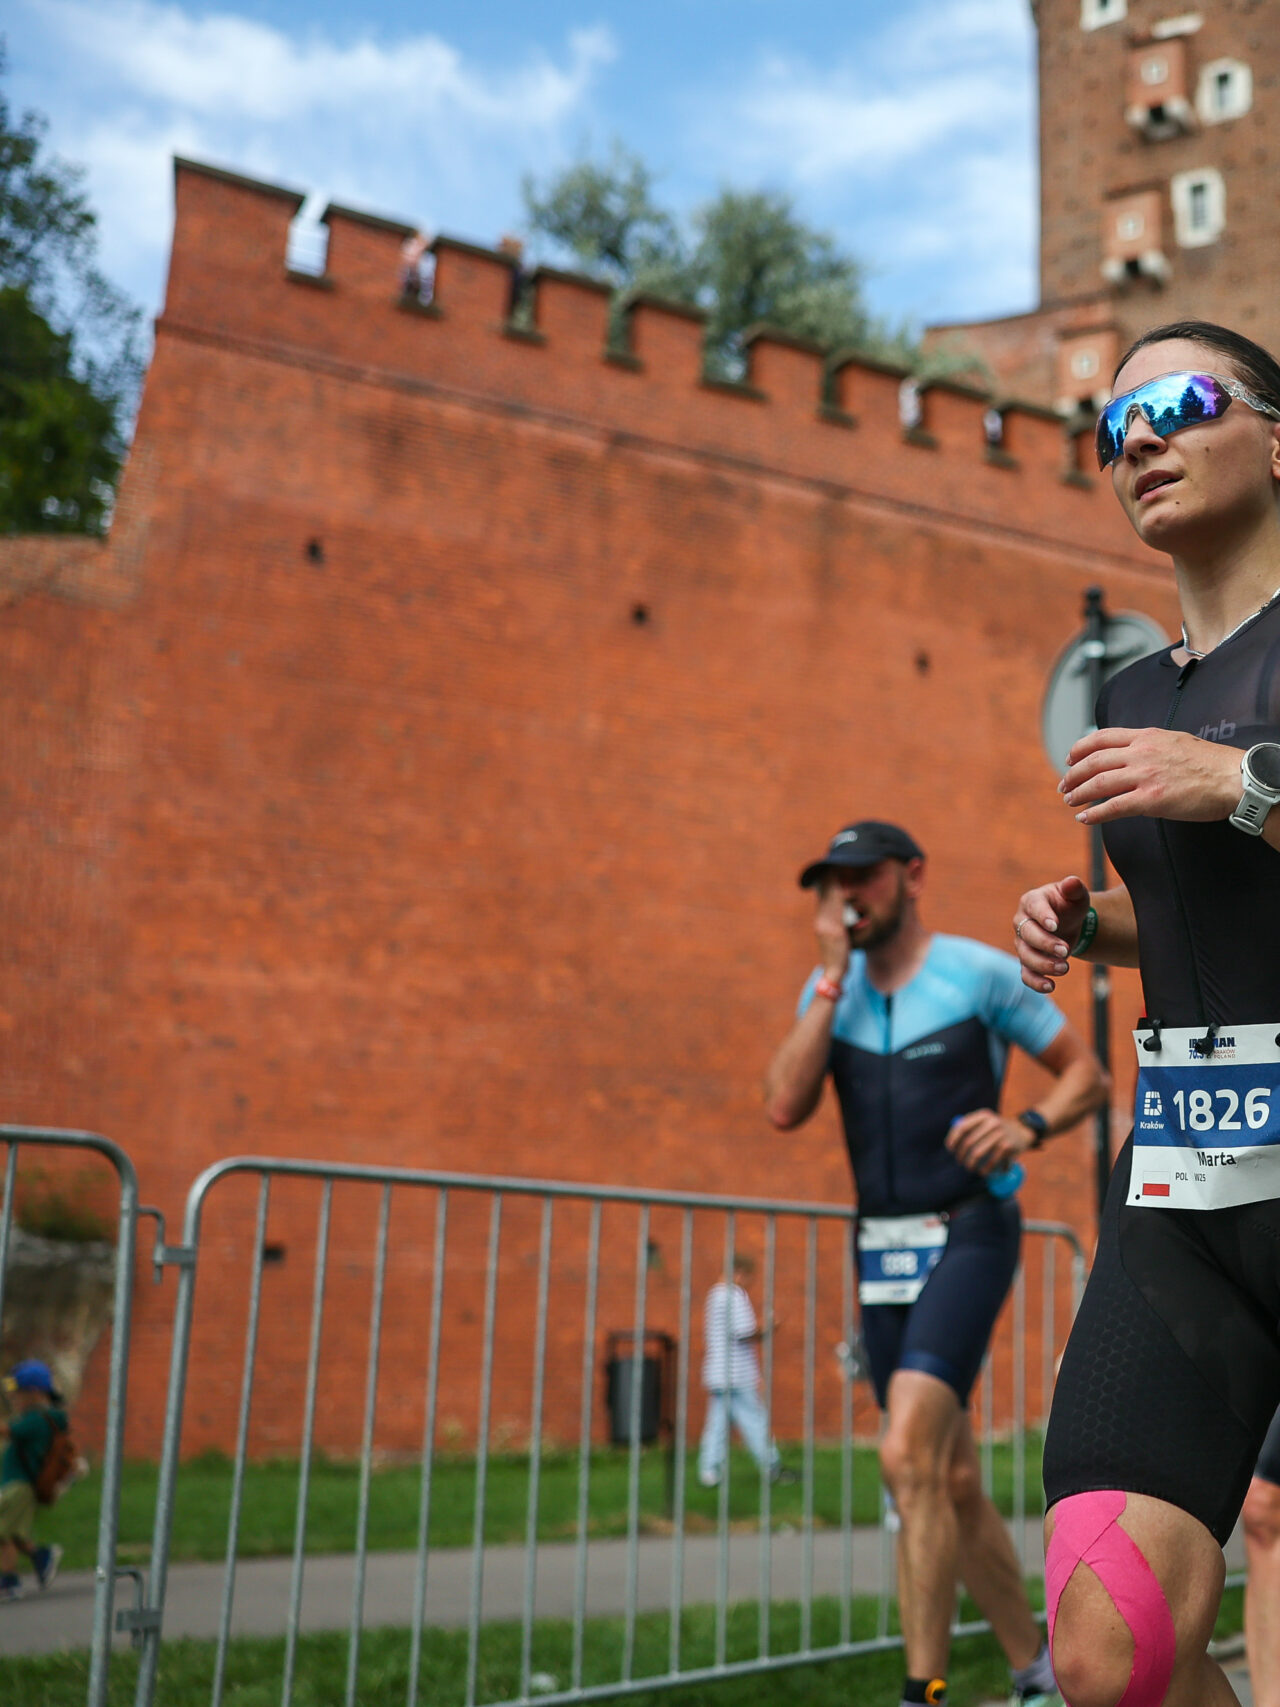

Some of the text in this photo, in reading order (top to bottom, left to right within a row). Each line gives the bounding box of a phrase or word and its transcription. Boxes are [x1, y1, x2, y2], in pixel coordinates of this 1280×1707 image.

[1172, 1087, 1271, 1131] 1826
[1139, 1121, 1165, 1130] Kraków
[1196, 1151, 1237, 1167] Marta
[1175, 1172, 1206, 1182] POL W25
